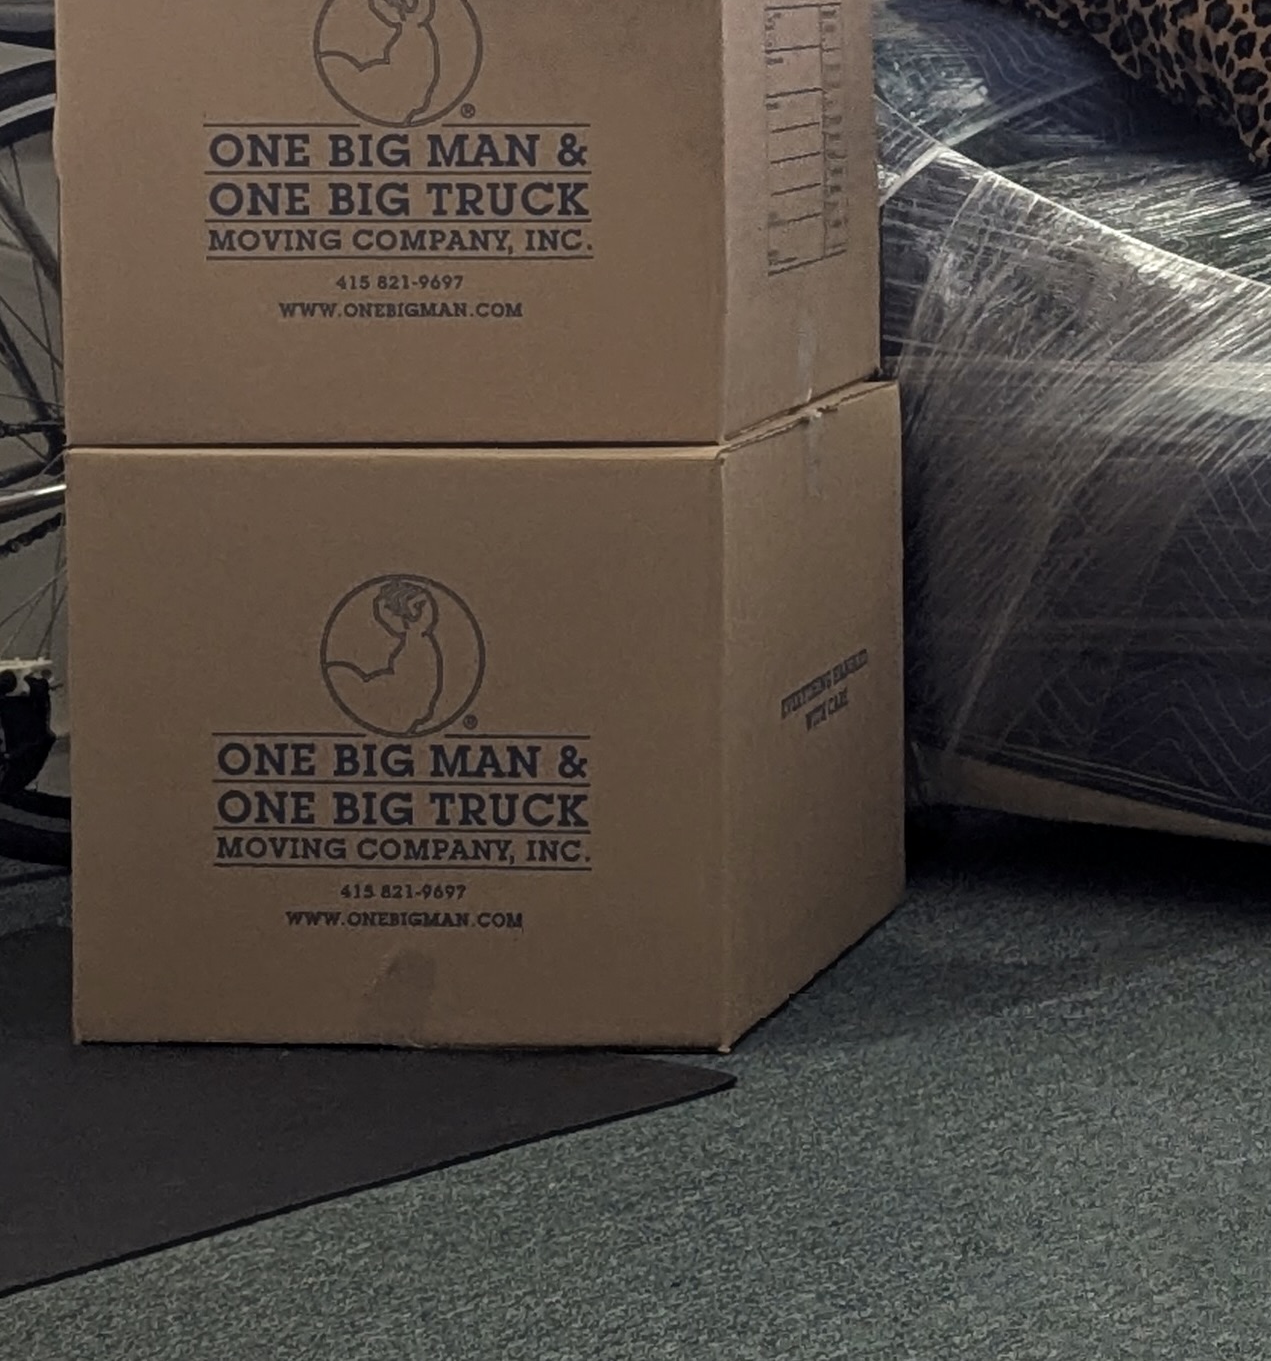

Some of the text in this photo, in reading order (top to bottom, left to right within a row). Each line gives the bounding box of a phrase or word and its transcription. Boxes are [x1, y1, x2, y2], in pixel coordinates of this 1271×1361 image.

[209, 134, 587, 167] ONE BIG MAN &
[209, 182, 589, 216] ONE BIG TRUCK
[208, 229, 593, 255] MOVING COMPANY, INC.
[336, 275, 464, 290] 415 821-9697
[279, 302, 523, 318] WWW.ONEBIGMAN.COM
[217, 742, 588, 778] ONE BIG MAN &
[217, 790, 590, 827] ONE BIG TRUCK
[216, 836, 591, 865] MOVING COMPANY, INC.
[340, 884, 467, 900] 415 821-9697
[285, 911, 523, 928] WWW.ONEBIGMAN.COM
